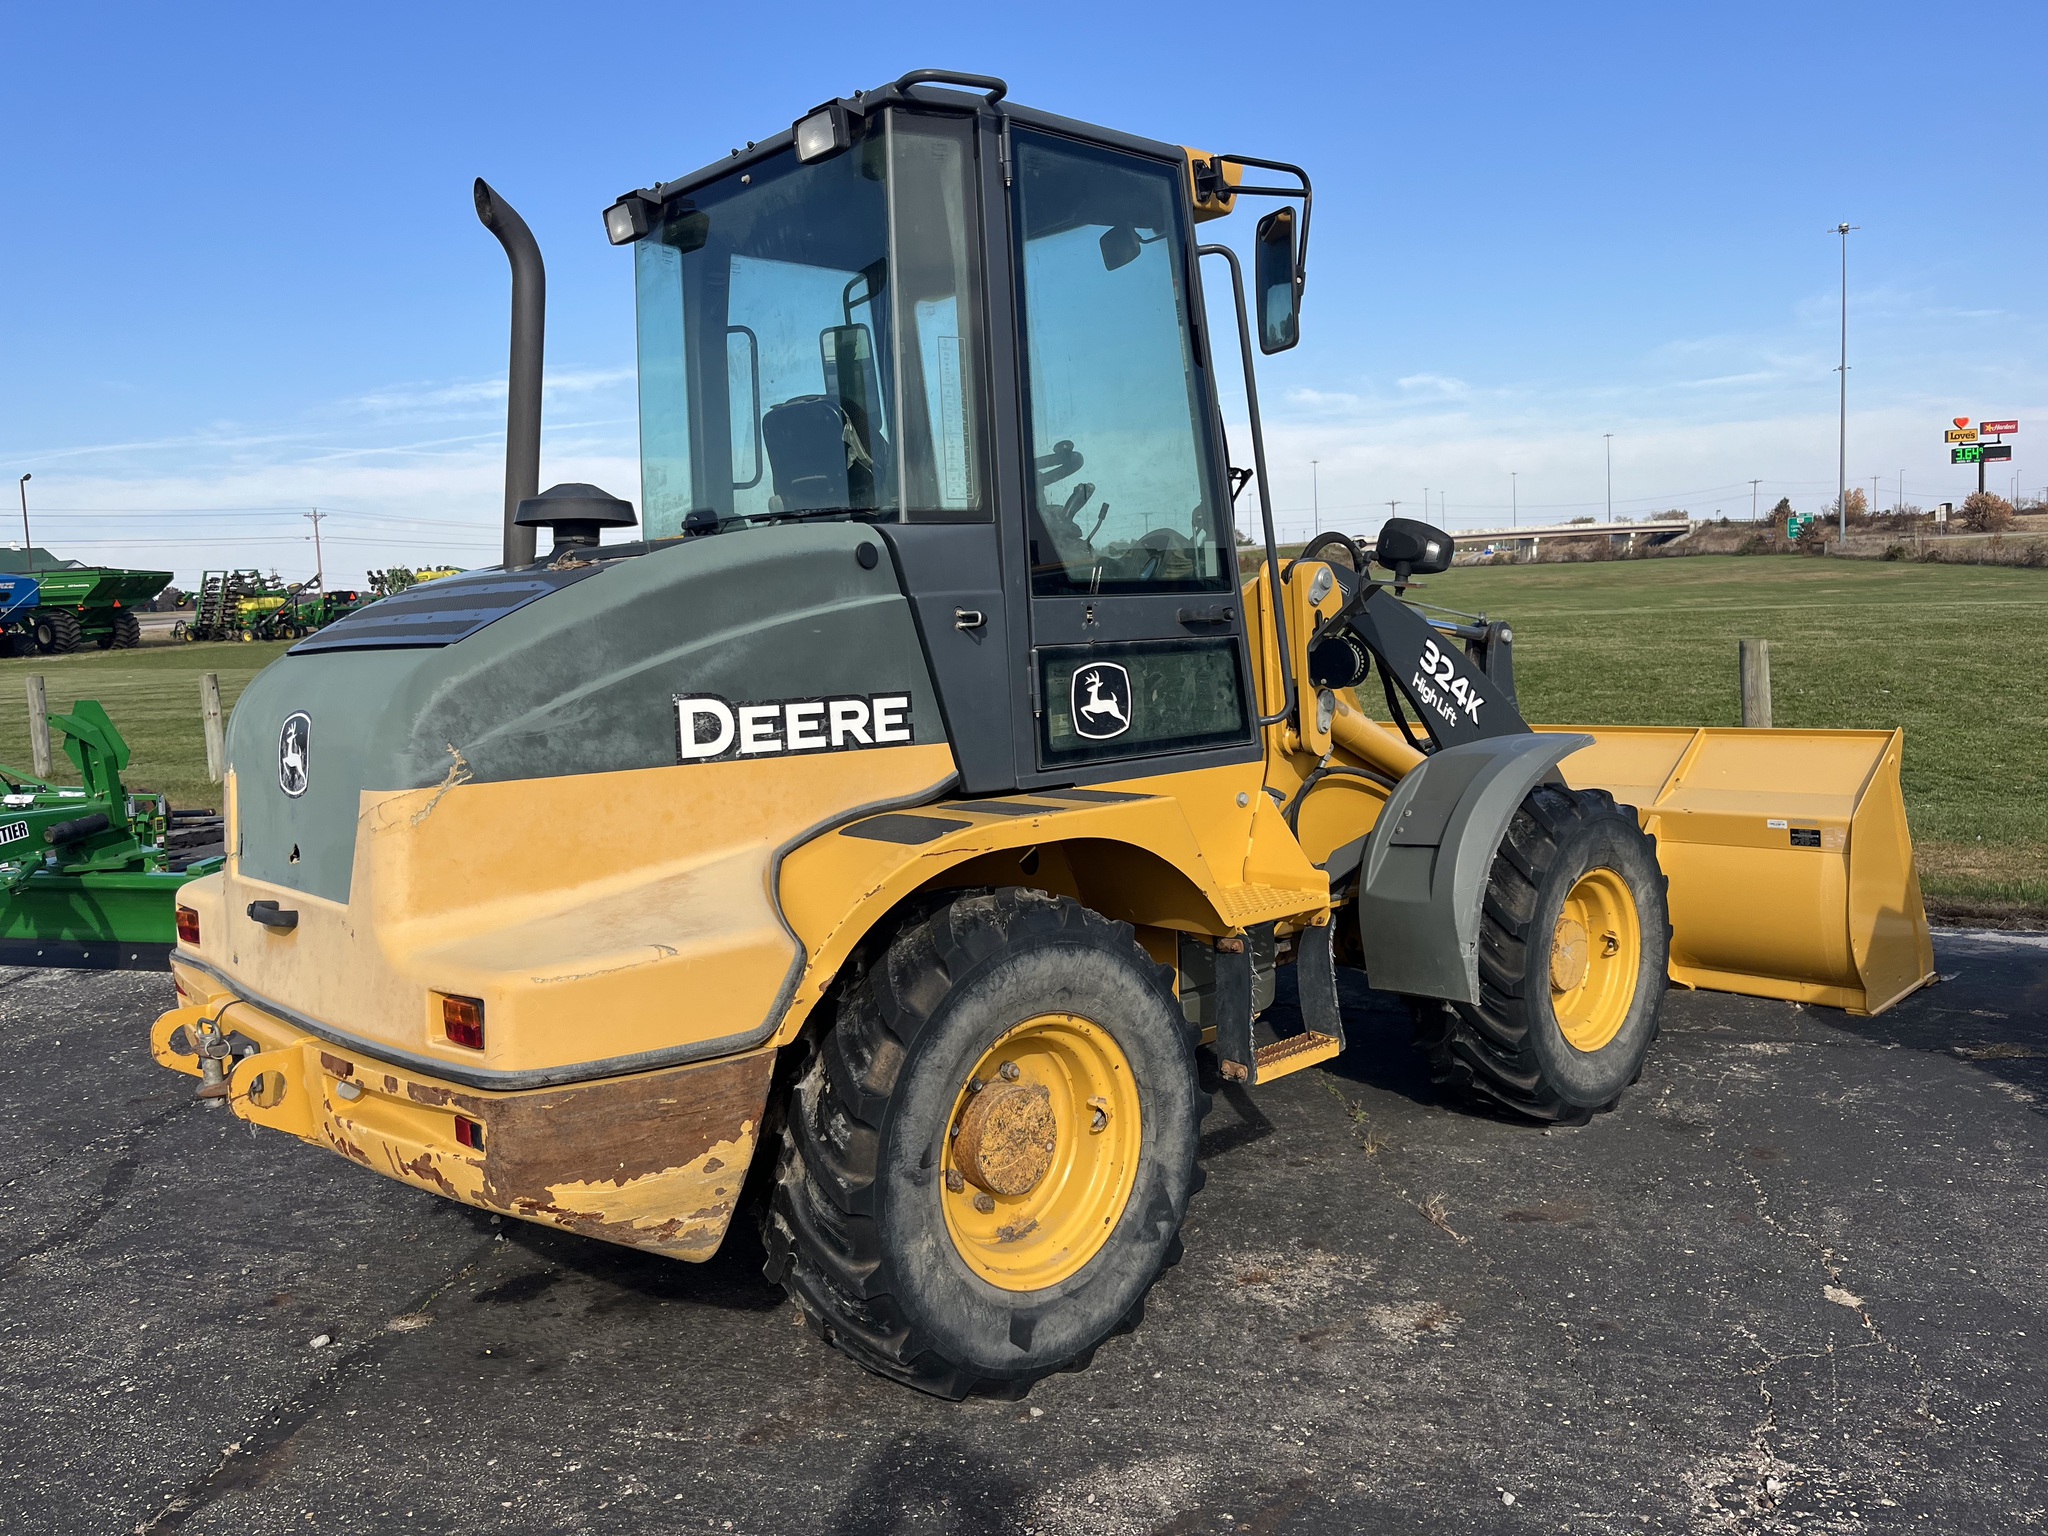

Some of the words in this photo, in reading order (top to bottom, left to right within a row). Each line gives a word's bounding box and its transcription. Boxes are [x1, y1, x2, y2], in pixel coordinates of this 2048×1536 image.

[1950, 431, 1976, 440] Love's
[1412, 671, 1438, 704] High
[1436, 697, 1458, 727] Lift
[1419, 639, 1485, 725] 324K
[678, 696, 911, 759] DEERE
[0, 821, 28, 844] TIER
